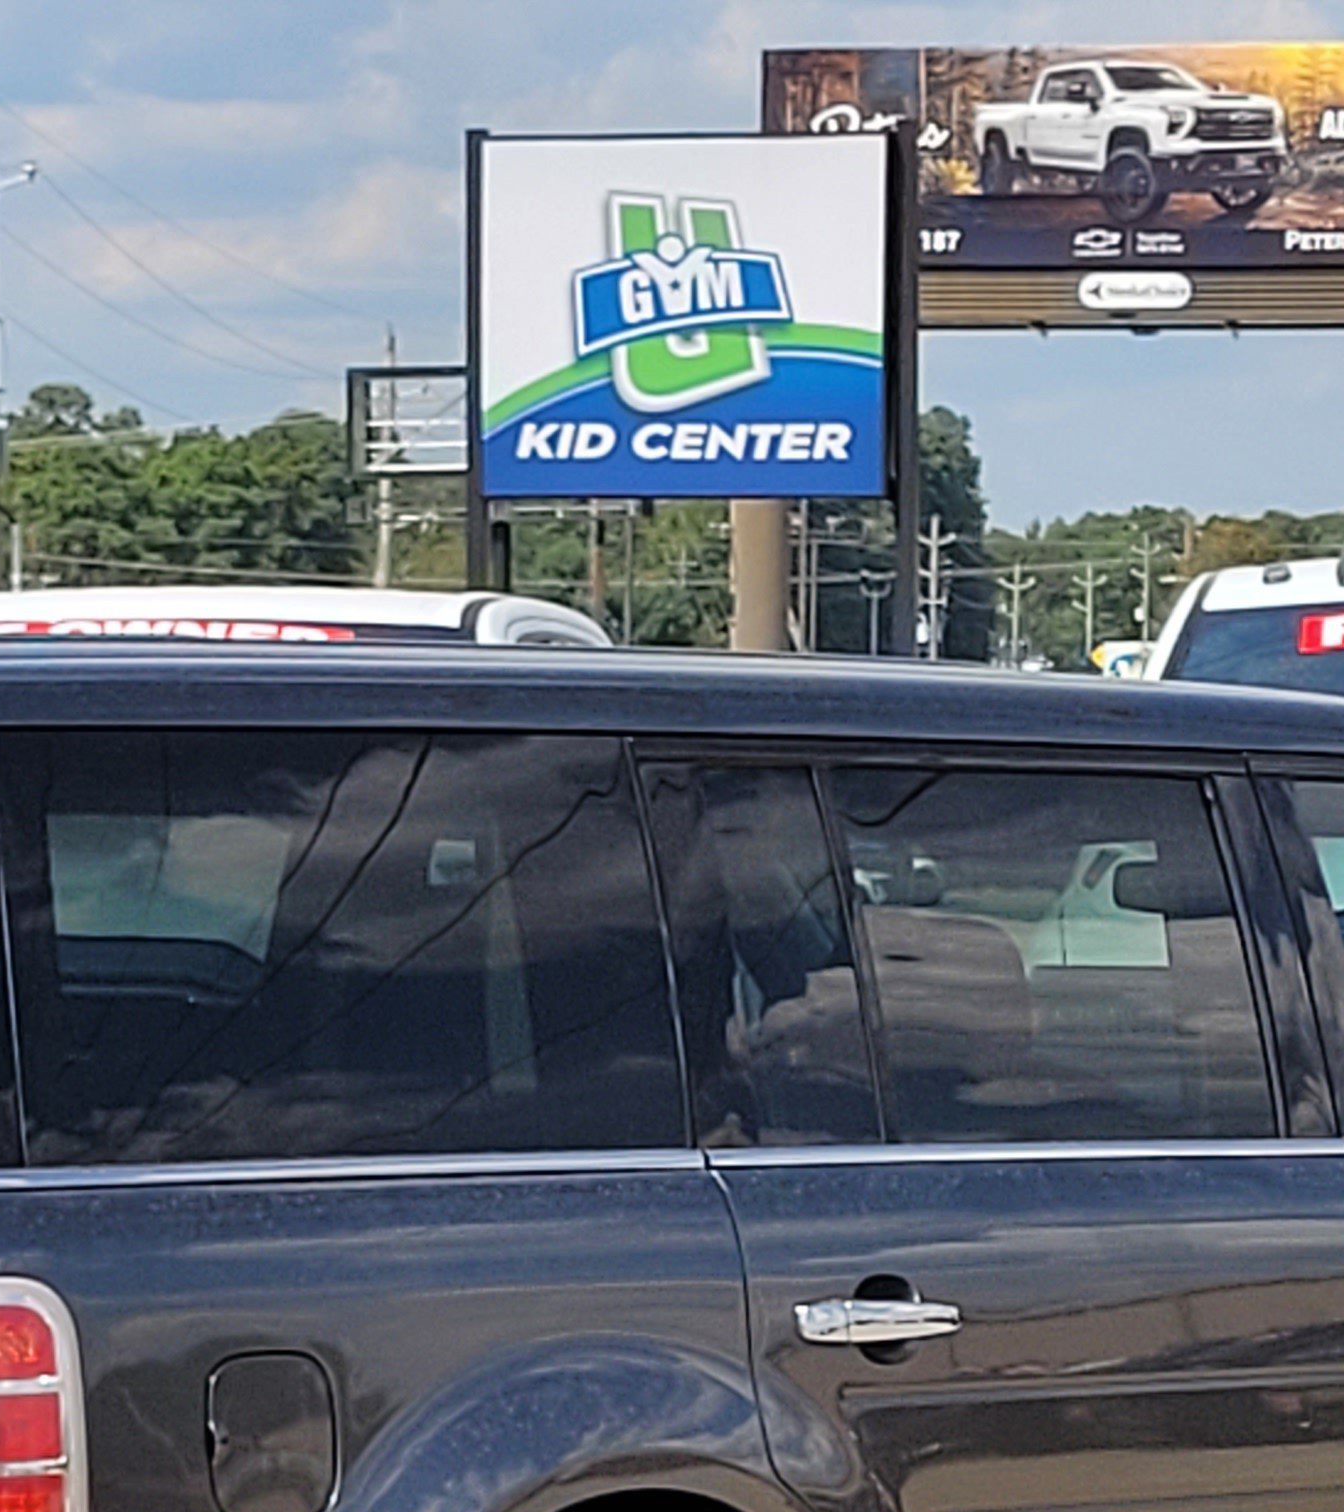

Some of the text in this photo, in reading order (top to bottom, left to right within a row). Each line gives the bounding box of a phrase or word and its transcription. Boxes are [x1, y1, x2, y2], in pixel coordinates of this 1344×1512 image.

[618, 248, 747, 325] GYM
[516, 422, 853, 461] KID CENTER
